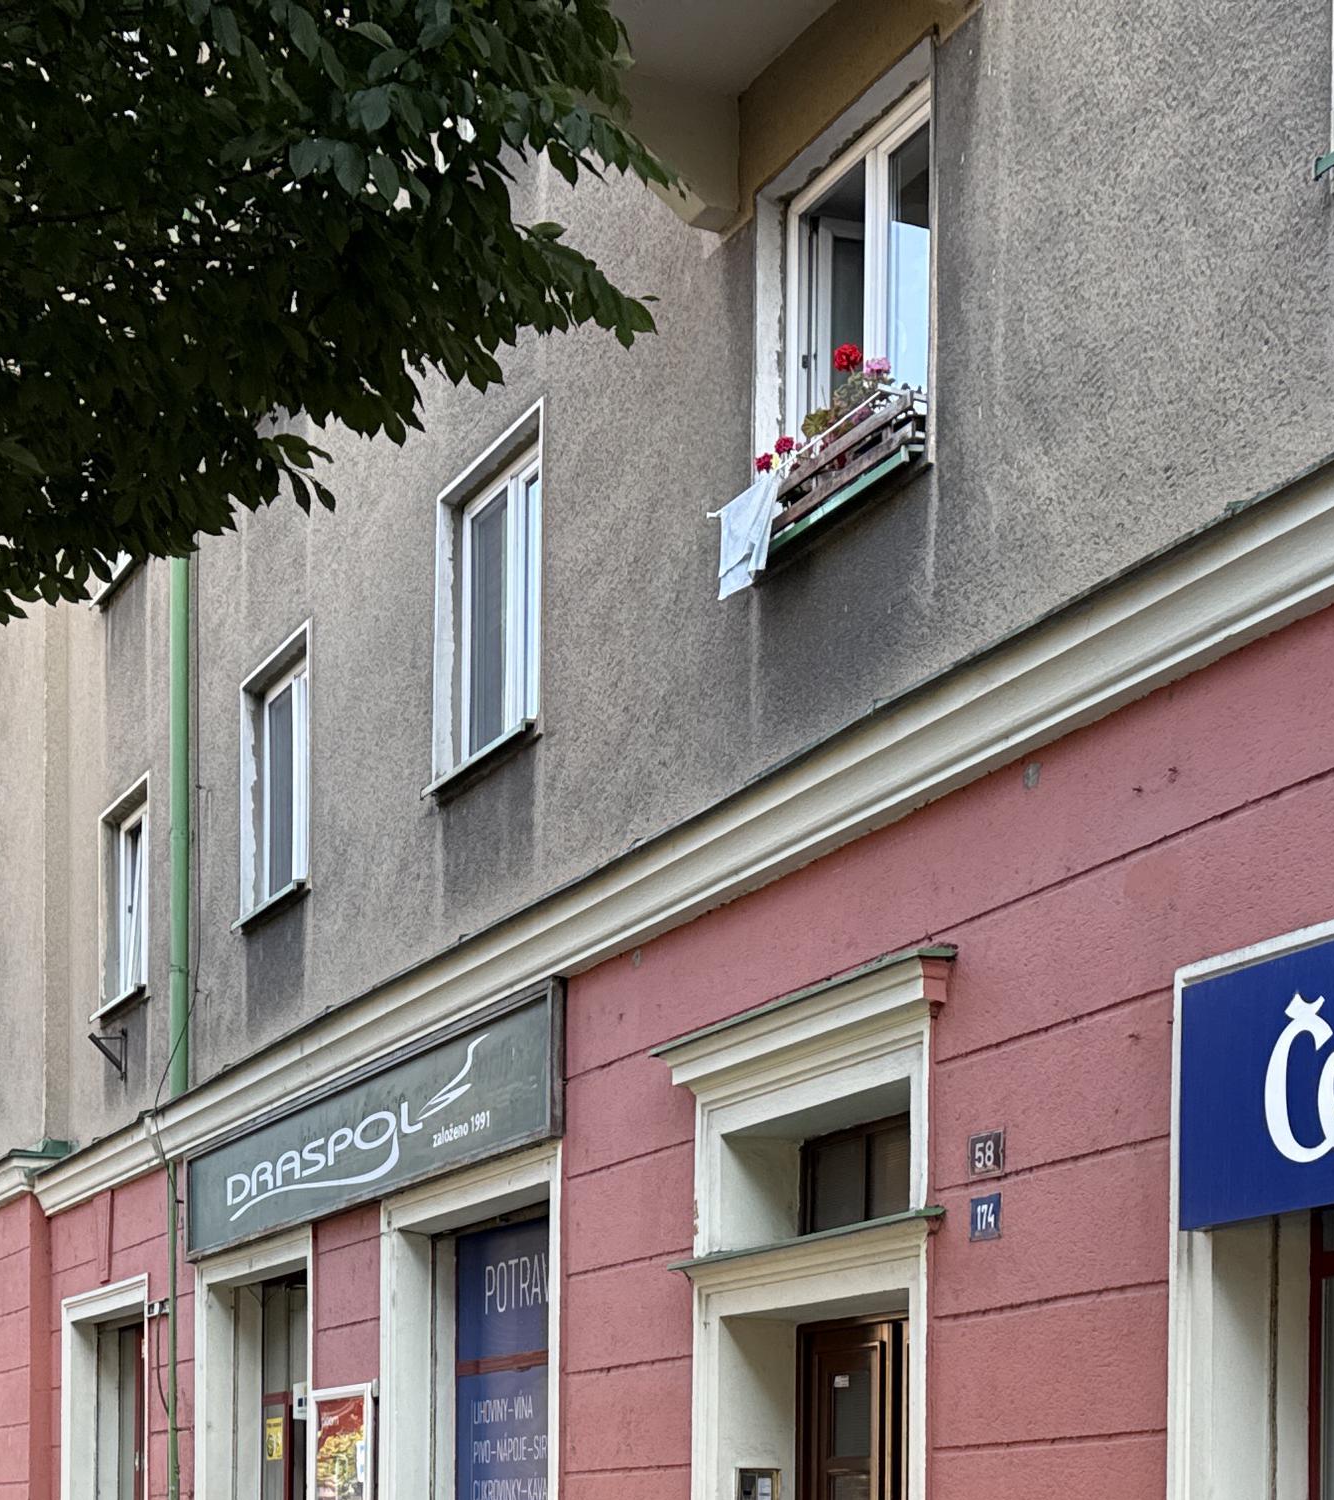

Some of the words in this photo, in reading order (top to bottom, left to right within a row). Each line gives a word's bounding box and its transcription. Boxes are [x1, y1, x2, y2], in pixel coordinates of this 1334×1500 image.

[432, 1122, 469, 1148] založeno
[470, 1110, 490, 1134] 1991
[226, 1101, 423, 1208] DRASPOL
[975, 1140, 994, 1168] 58
[976, 1203, 995, 1231] 174
